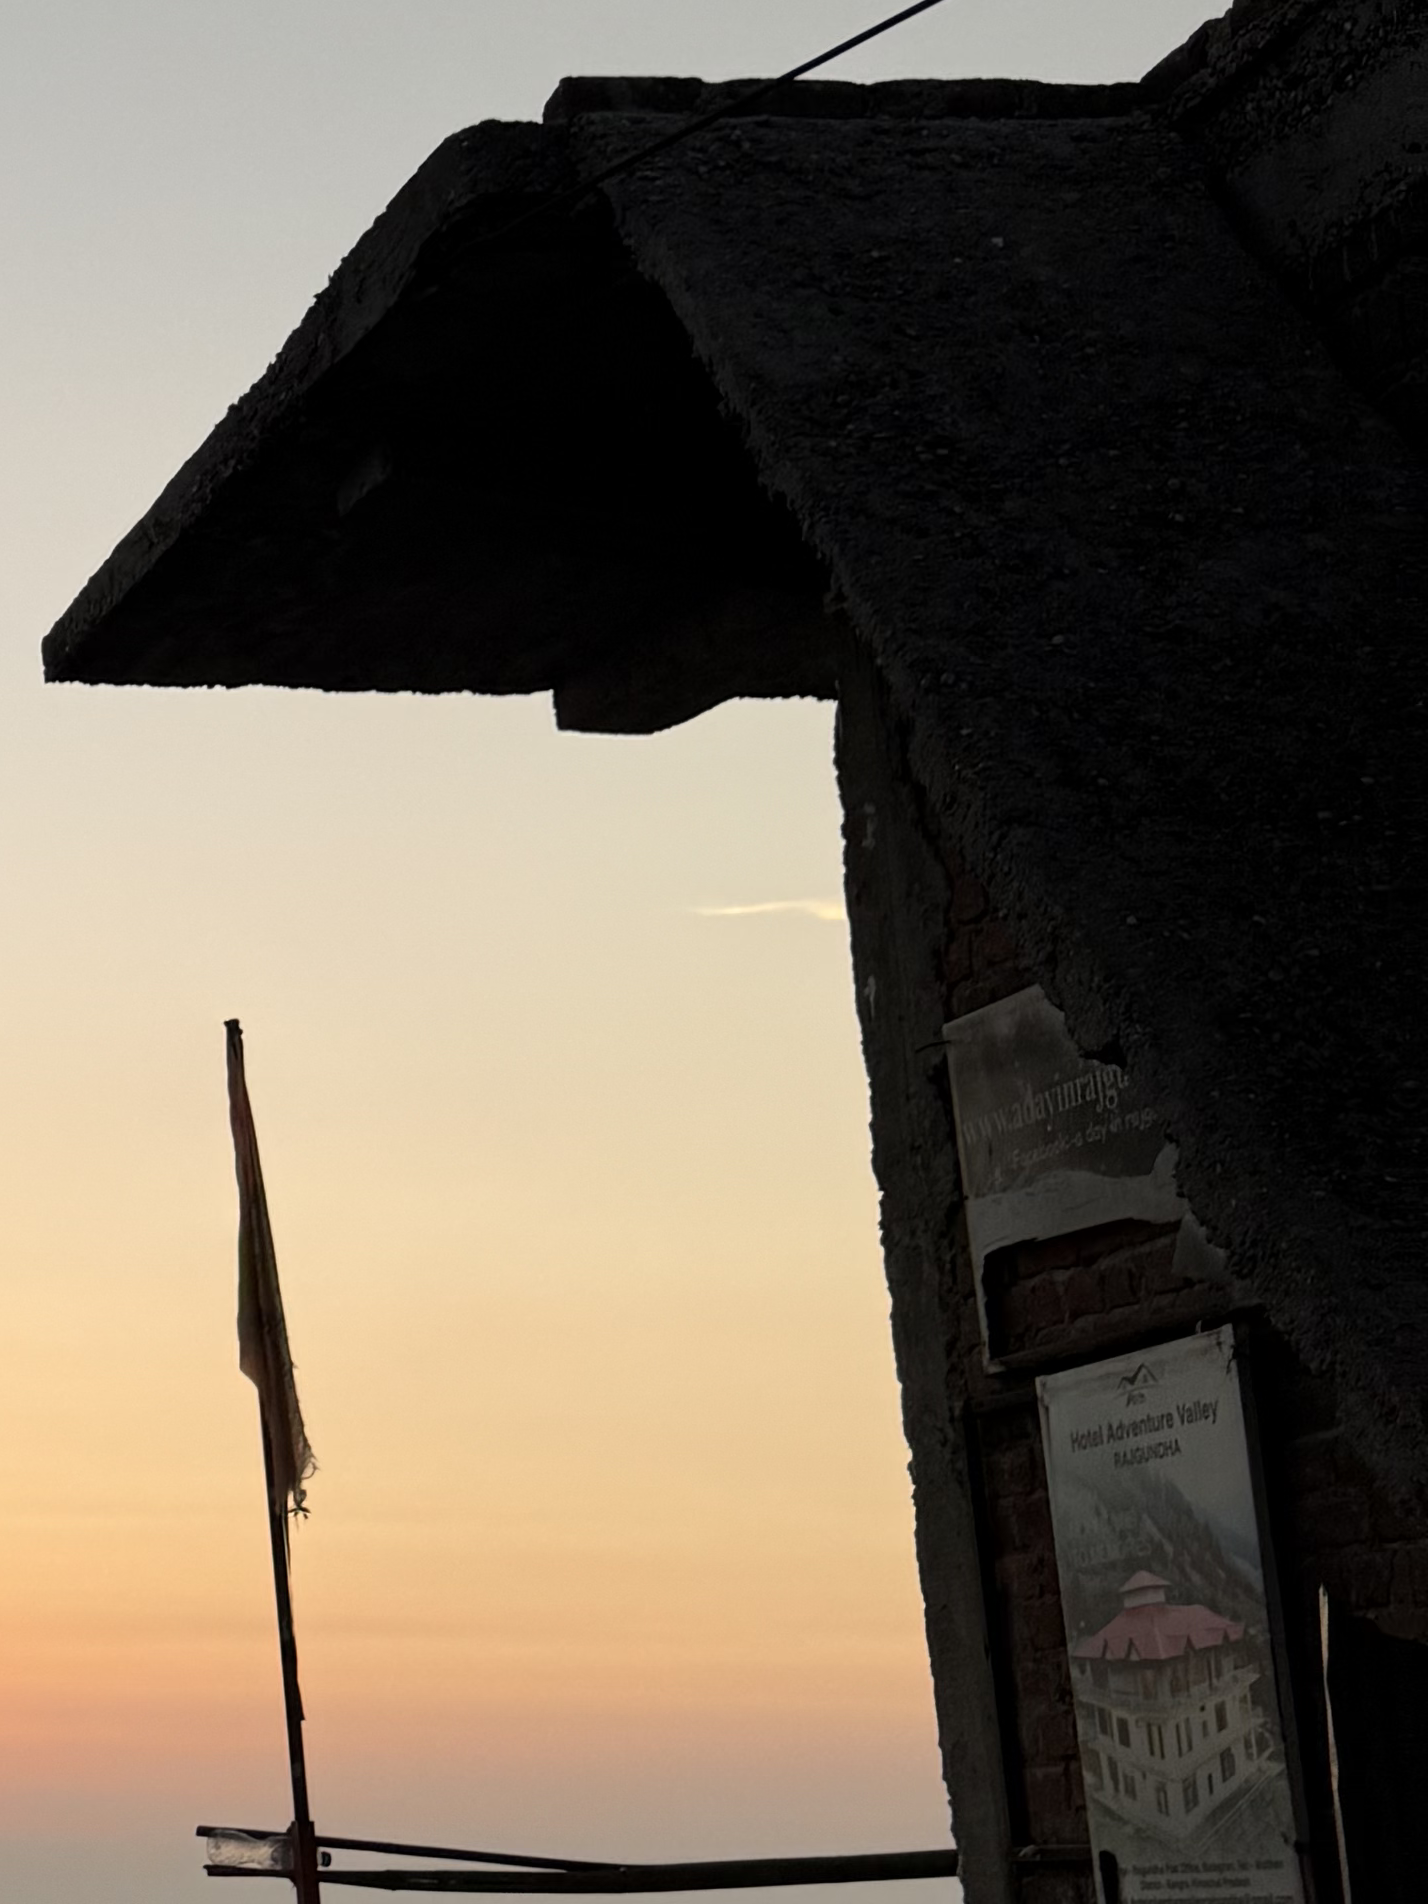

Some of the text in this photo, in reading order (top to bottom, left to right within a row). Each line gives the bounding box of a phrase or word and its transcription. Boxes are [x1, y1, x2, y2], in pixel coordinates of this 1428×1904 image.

[1070, 1400, 1219, 1453] Hotel Adventure Valley
